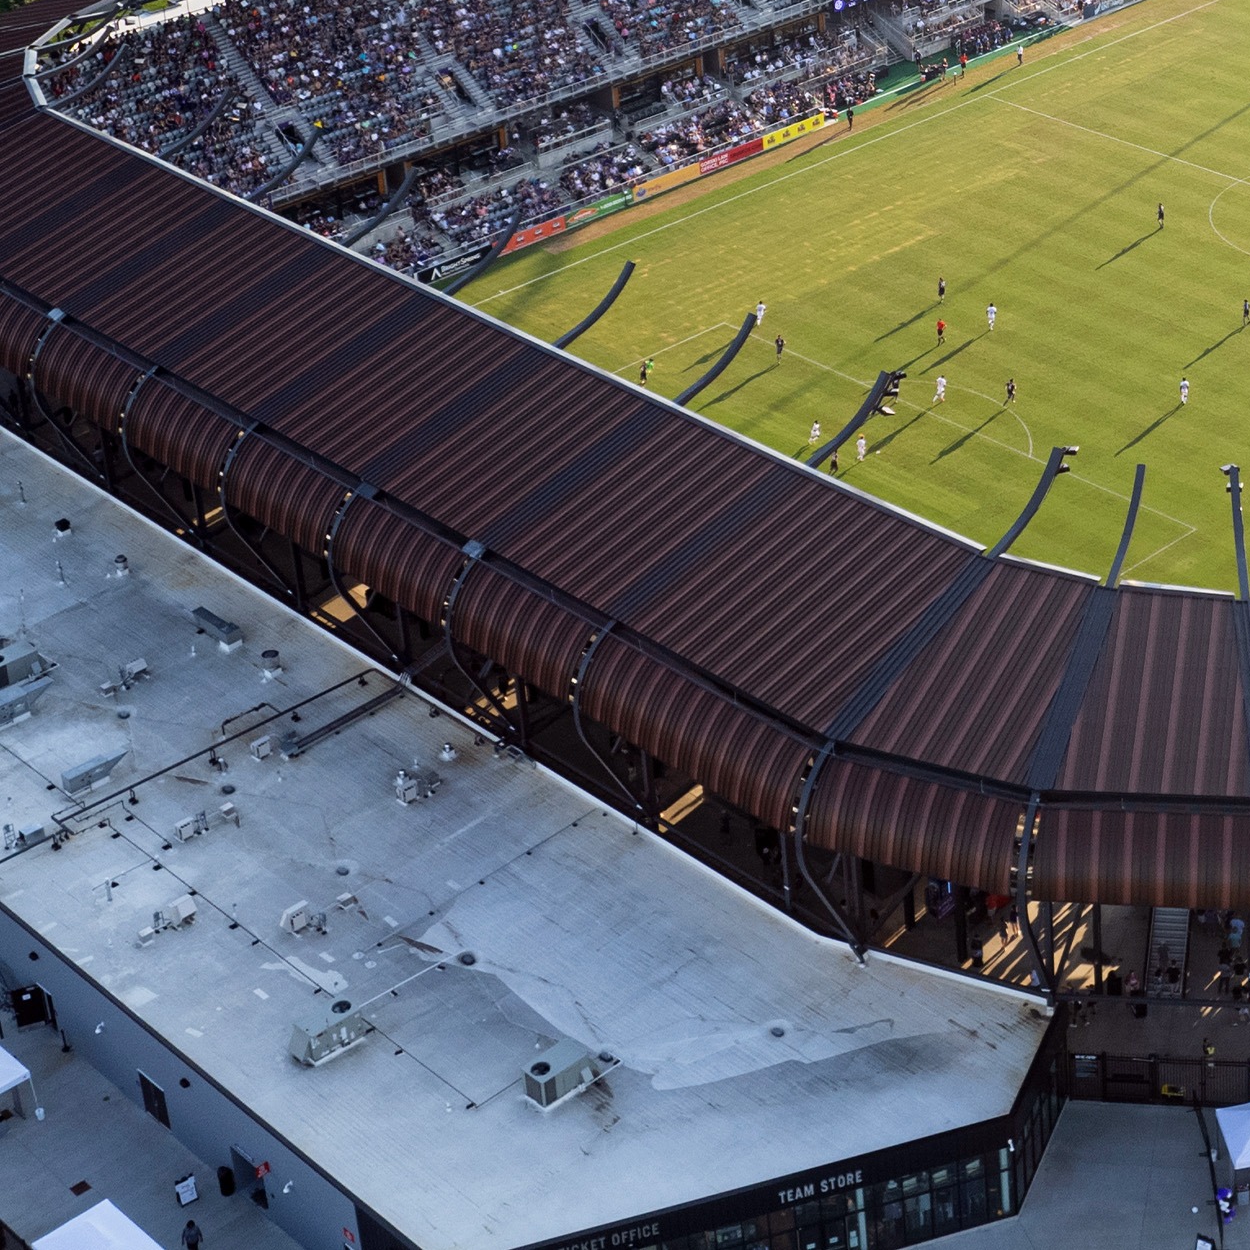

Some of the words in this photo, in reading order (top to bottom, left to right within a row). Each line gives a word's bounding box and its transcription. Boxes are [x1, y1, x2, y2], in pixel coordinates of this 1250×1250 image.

[778, 1183, 815, 1204] TEAM
[819, 1169, 863, 1193] STORE
[611, 1222, 661, 1246] OFFICE
